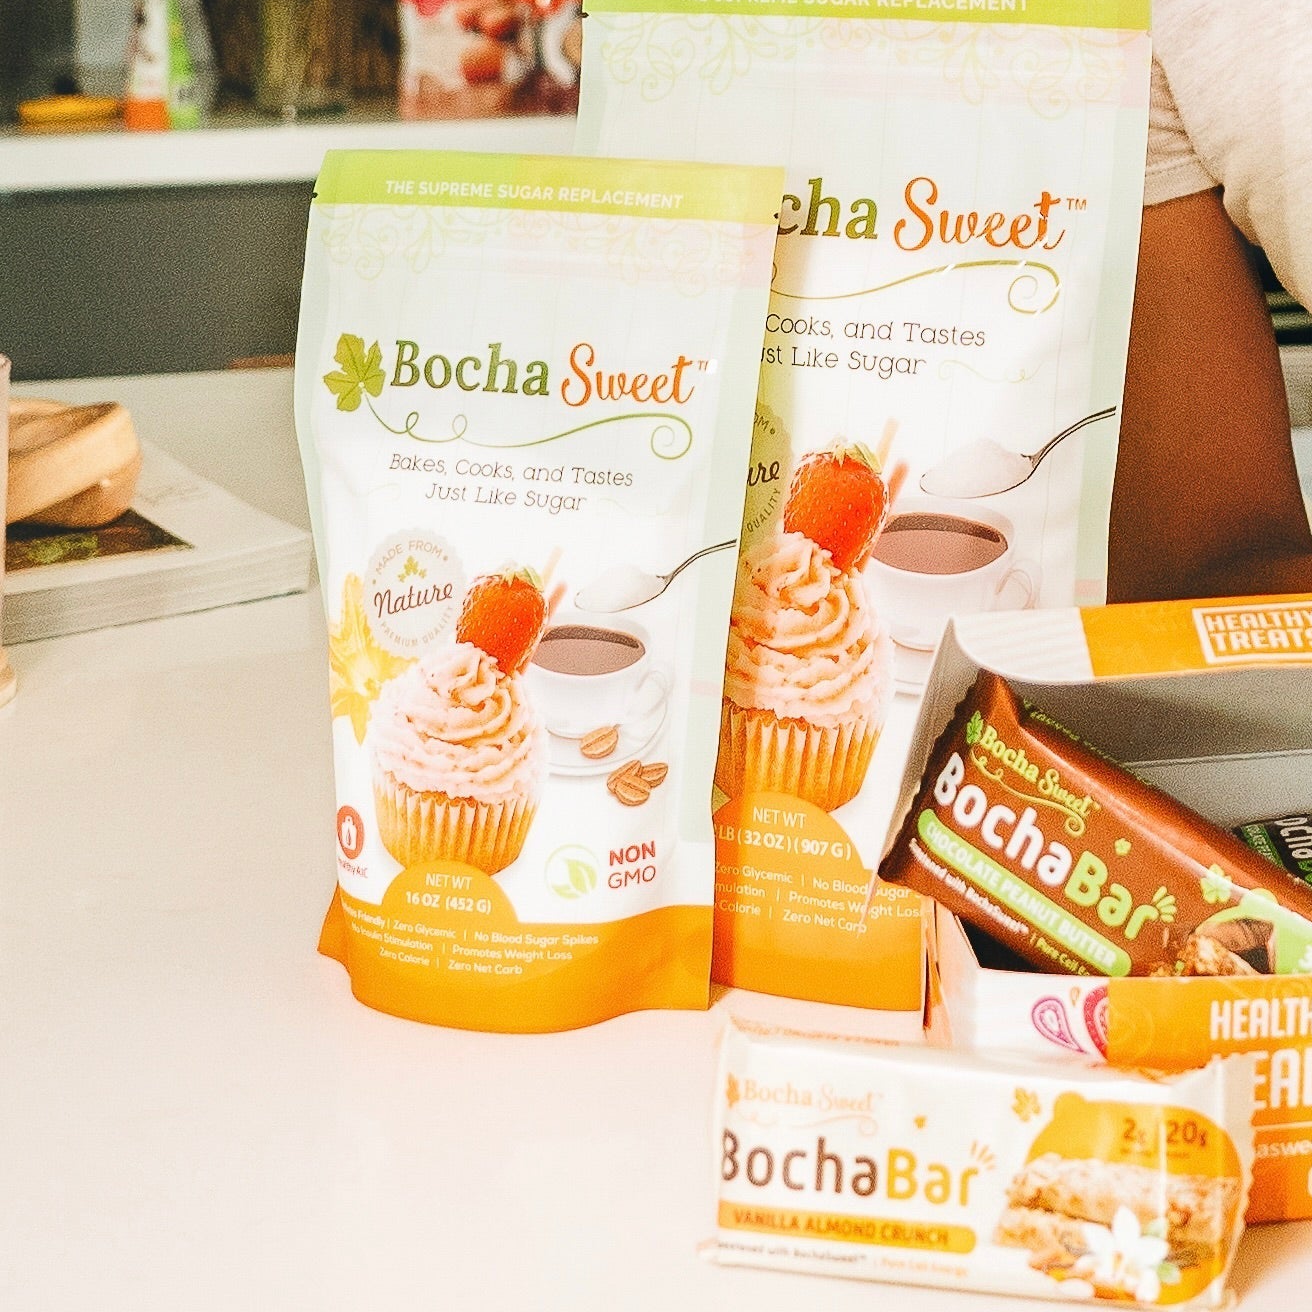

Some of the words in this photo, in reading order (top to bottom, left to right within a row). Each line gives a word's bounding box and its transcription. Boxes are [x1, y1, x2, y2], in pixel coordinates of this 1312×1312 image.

[385, 180, 414, 196] THE
[418, 181, 493, 199] SUPREME
[498, 184, 554, 203] SUGAR
[558, 186, 684, 210] REPLACEMENT
[775, 178, 879, 241] cha
[893, 177, 1066, 252] Sweet
[765, 313, 834, 340] Cooks,
[844, 317, 894, 342] and
[902, 322, 987, 348] Tastes
[390, 339, 550, 397] Bocha
[561, 343, 698, 408] Sweet
[791, 346, 839, 369] Like
[847, 349, 927, 386] Sugar
[389, 453, 448, 477] Bakes,
[455, 458, 515, 481] Cooks,
[523, 463, 564, 485] and
[571, 467, 634, 488] Tastes
[425, 482, 469, 503] Just
[475, 485, 517, 507] Like
[523, 489, 588, 514] Sugar
[746, 487, 781, 533] QUALITY
[375, 543, 404, 576] MADE
[408, 539, 443, 558] FROM
[374, 583, 453, 619] Nature
[979, 724, 1041, 783] Bocha
[753, 806, 781, 824] NET
[782, 809, 807, 828] WT
[608, 840, 657, 866] NON
[933, 752, 1160, 941] BochaBar
[425, 872, 450, 888] NET
[451, 874, 473, 891] WT
[607, 865, 657, 890] GMO
[741, 865, 793, 884] Glycemic
[812, 877, 830, 891] No
[832, 880, 869, 896] Blood
[406, 891, 420, 905] 16
[422, 891, 441, 908] OZ
[715, 883, 766, 899] mulation
[788, 891, 846, 911] Promotes
[896, 905, 920, 918] Los
[719, 899, 762, 917] Calorie
[782, 909, 812, 926] Zero
[814, 914, 836, 929] Net
[837, 916, 867, 934] Carb
[383, 931, 433, 953] Stimulation
[452, 943, 503, 961] Promotes
[504, 947, 545, 964] Weight
[546, 950, 573, 962] Loss
[393, 916, 414, 932] Zero
[415, 922, 456, 940] Glycemic
[474, 931, 490, 942] No
[491, 931, 523, 945] Blood
[525, 933, 561, 949] Sugar
[562, 932, 600, 947] Spikes
[379, 946, 397, 961] Zero
[397, 949, 430, 967] Calorie
[448, 959, 473, 973] Zero
[473, 962, 493, 974] Net
[494, 963, 523, 976] Carb
[744, 1079, 813, 1106] Bocha
[721, 1127, 979, 1207] BochaBar
[734, 1208, 799, 1229] VANILLA
[804, 1216, 877, 1240] ALMOND
[881, 1222, 949, 1246] CRUNCH
